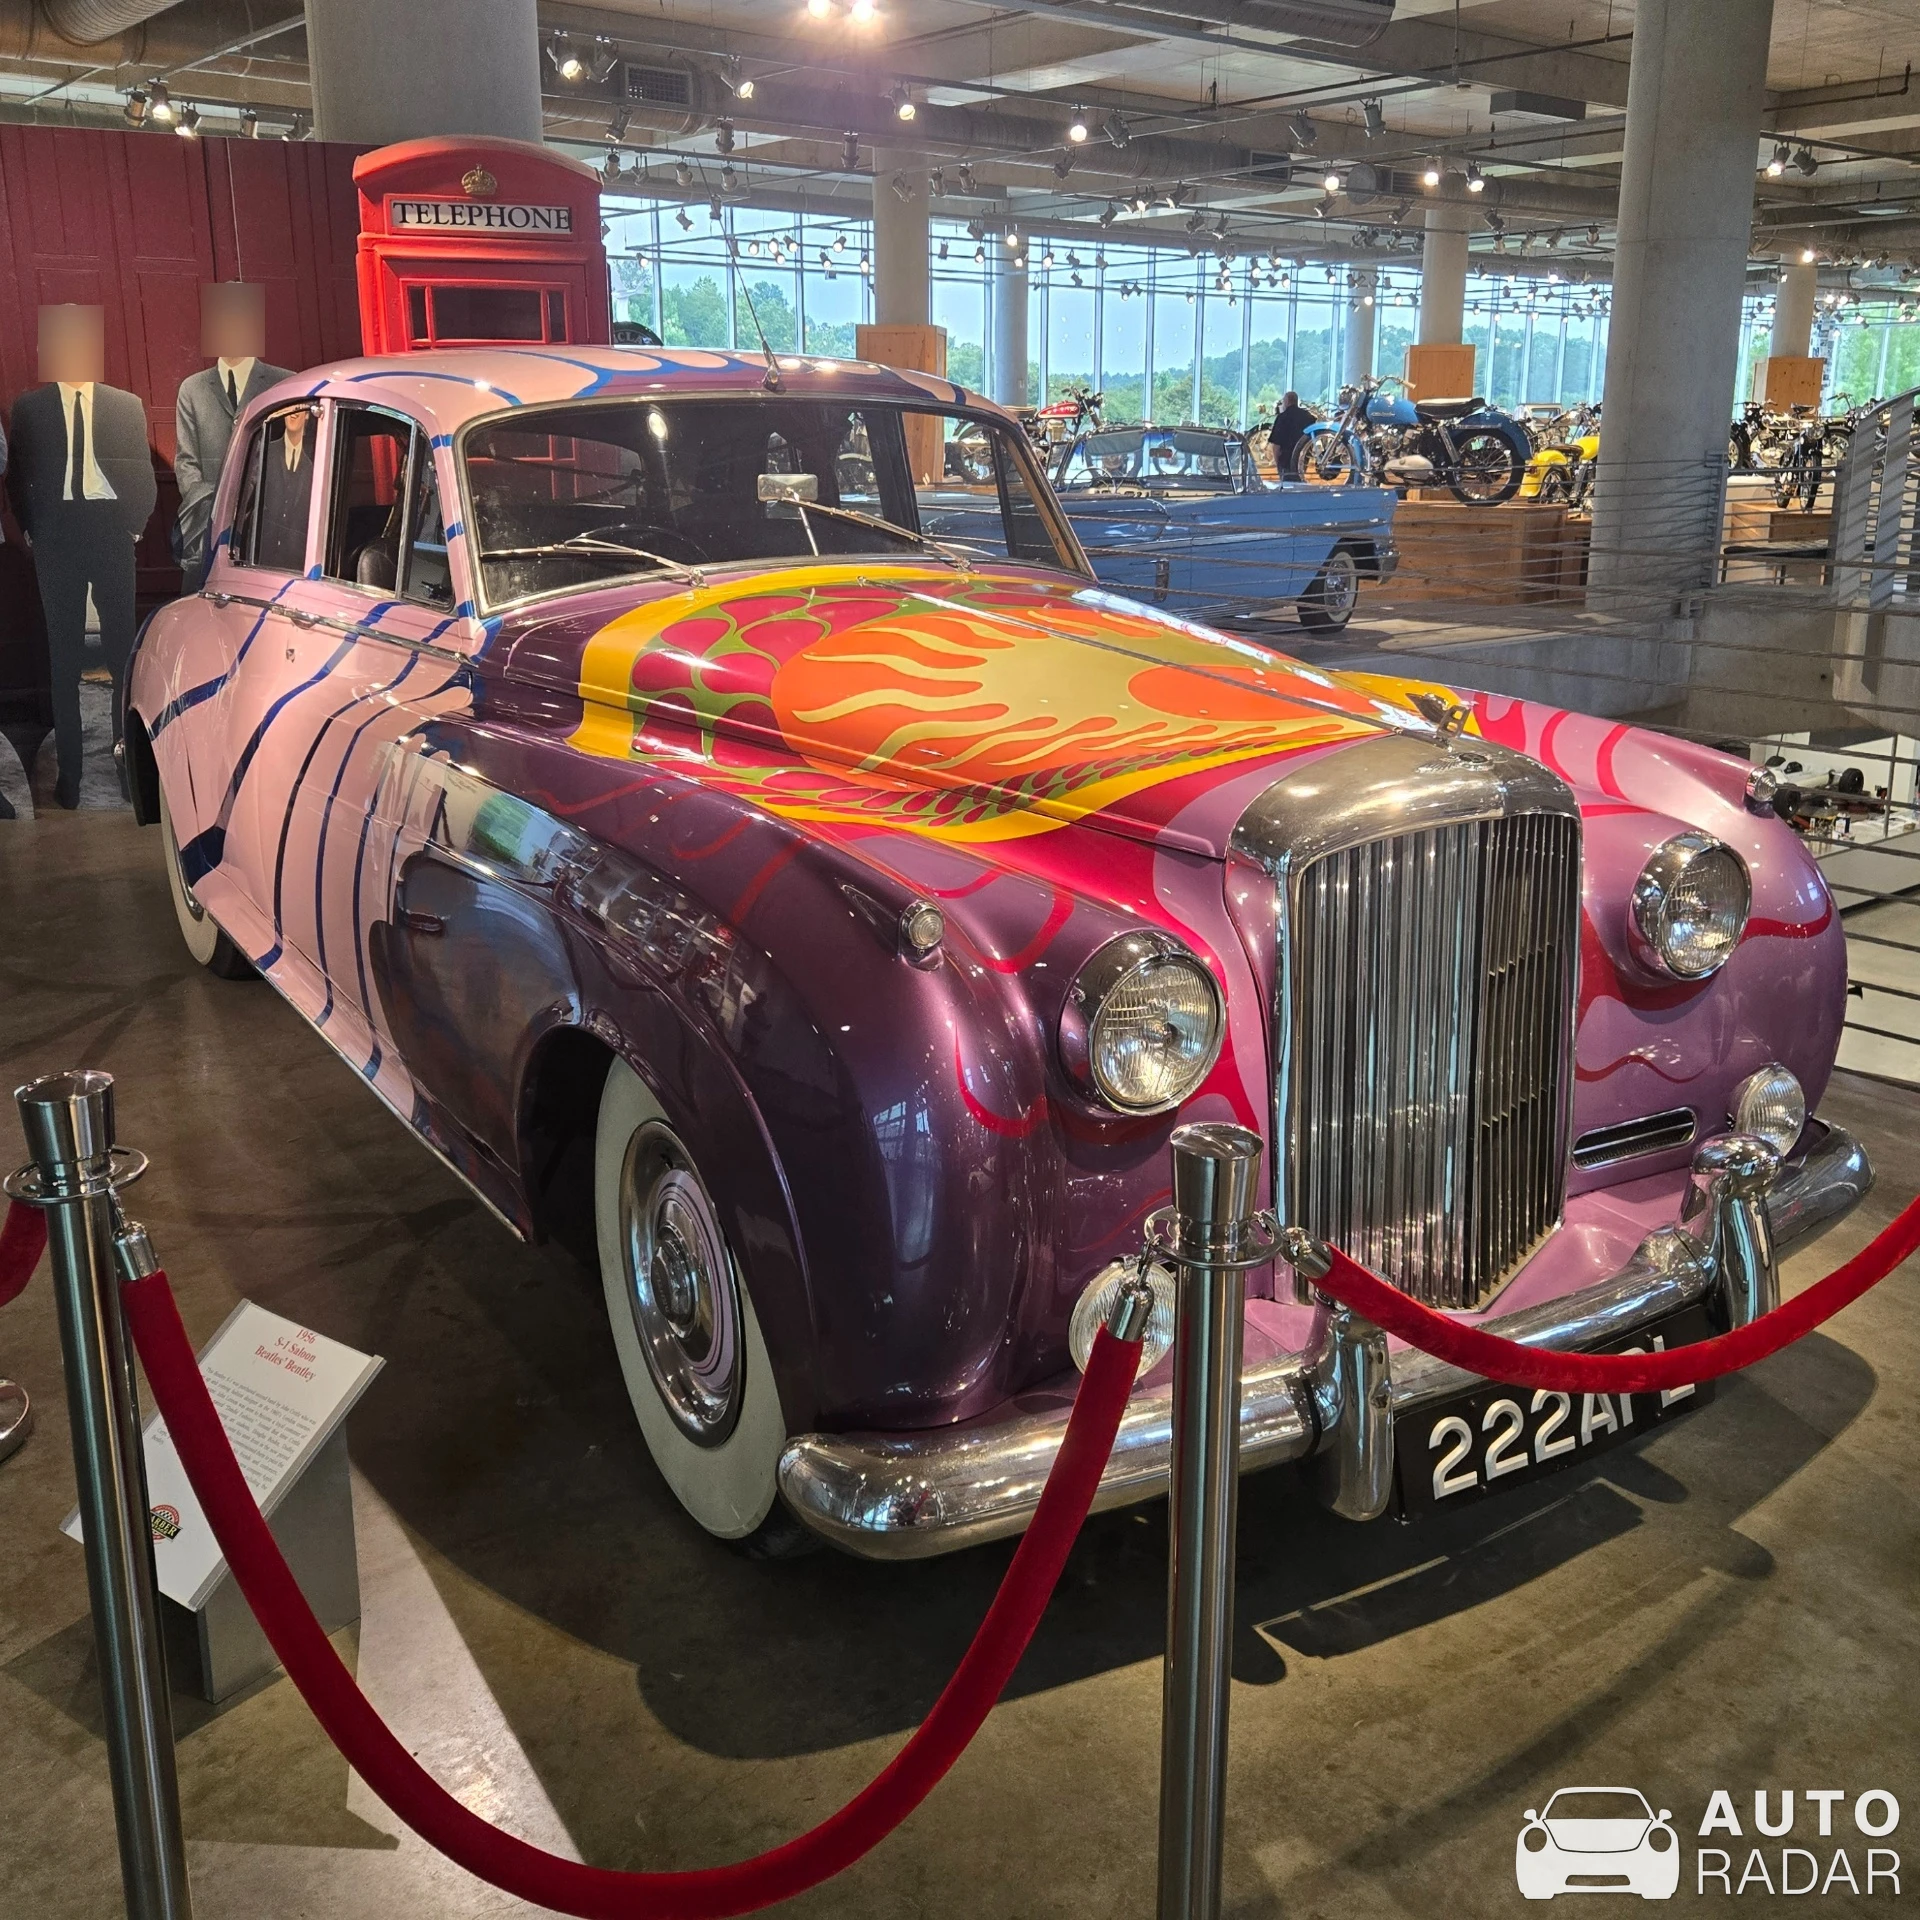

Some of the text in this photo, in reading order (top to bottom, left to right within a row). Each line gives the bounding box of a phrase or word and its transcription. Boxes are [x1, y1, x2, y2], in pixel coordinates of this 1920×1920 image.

[393, 202, 571, 230] TELEPHONE
[296, 1329, 317, 1344] 1956
[274, 1337, 317, 1362] S-1 Saloon
[255, 1345, 316, 1382] Beatles' Bentley
[151, 1515, 178, 1536] ARBER
